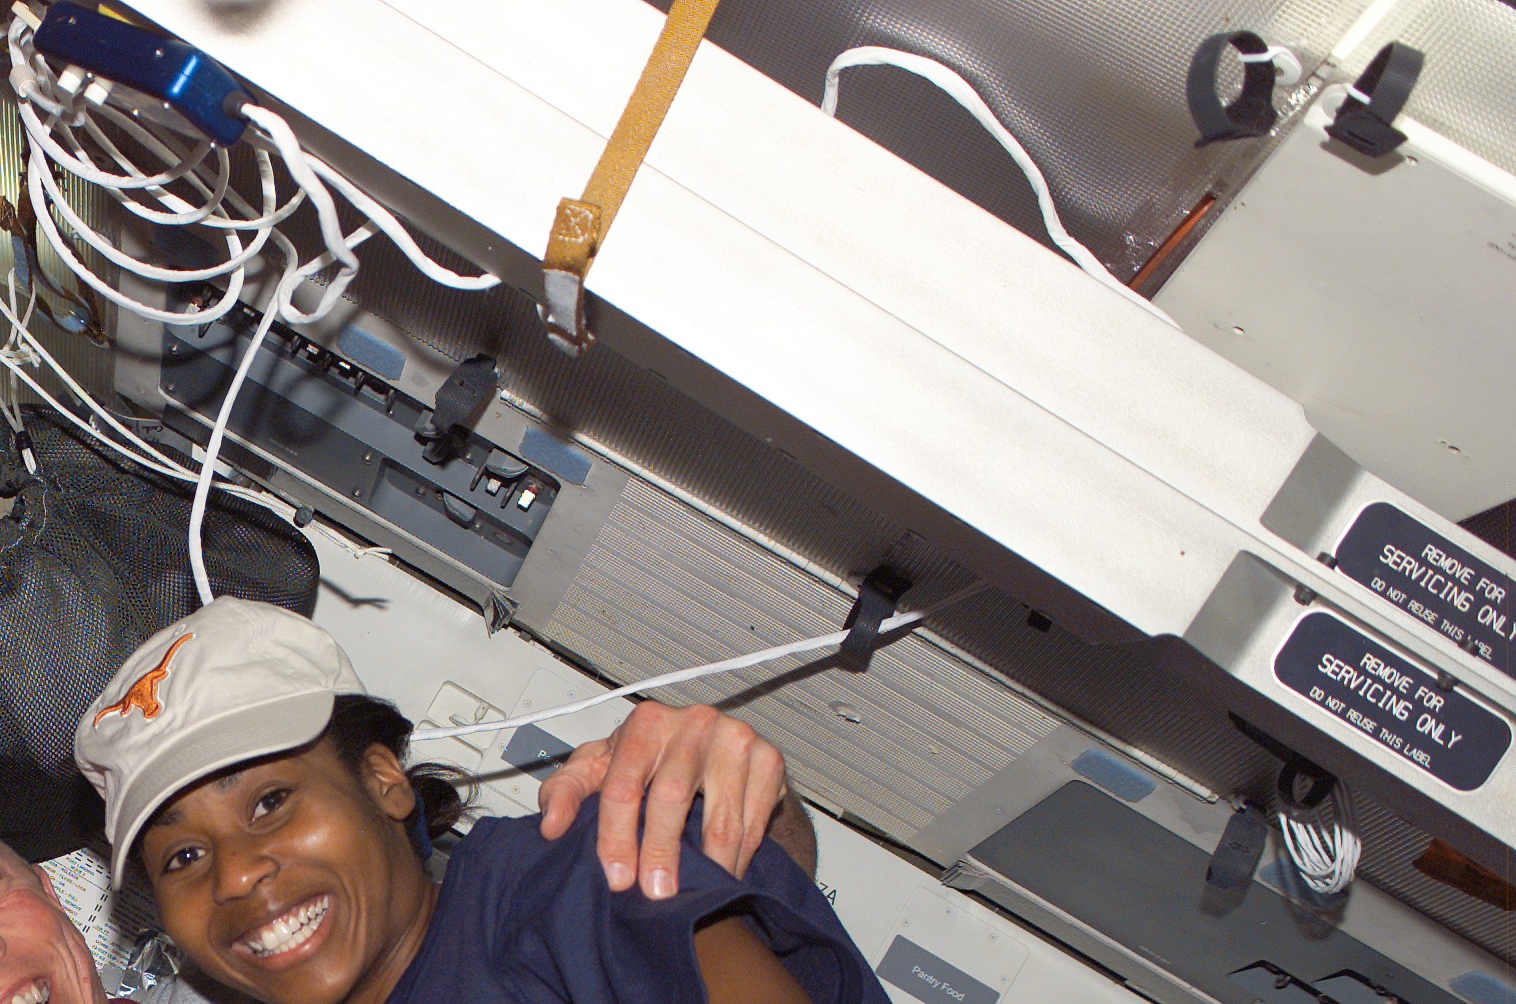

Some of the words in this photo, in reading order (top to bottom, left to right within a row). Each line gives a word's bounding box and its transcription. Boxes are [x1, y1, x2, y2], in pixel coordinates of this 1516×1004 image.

[1379, 545, 1474, 613] SERVICING
[1421, 544, 1475, 586] REMOVE
[1476, 577, 1506, 604] FOR
[1371, 577, 1386, 592] DO
[1387, 586, 1407, 604] NOT
[1408, 599, 1438, 625] REUSE
[1441, 619, 1465, 642] THIS
[1317, 654, 1412, 721] SERVICING
[1416, 713, 1462, 749] ONLY
[1360, 653, 1413, 694] REMOVE
[1414, 686, 1445, 713] FOR
[1309, 686, 1324, 701] DO
[1325, 695, 1346, 713] NOT
[1346, 708, 1377, 733] REUSE
[1380, 727, 1403, 749] THIS
[1404, 743, 1431, 768] LABEL
[912, 965, 941, 988] Pantry
[941, 982, 965, 1001] Food
